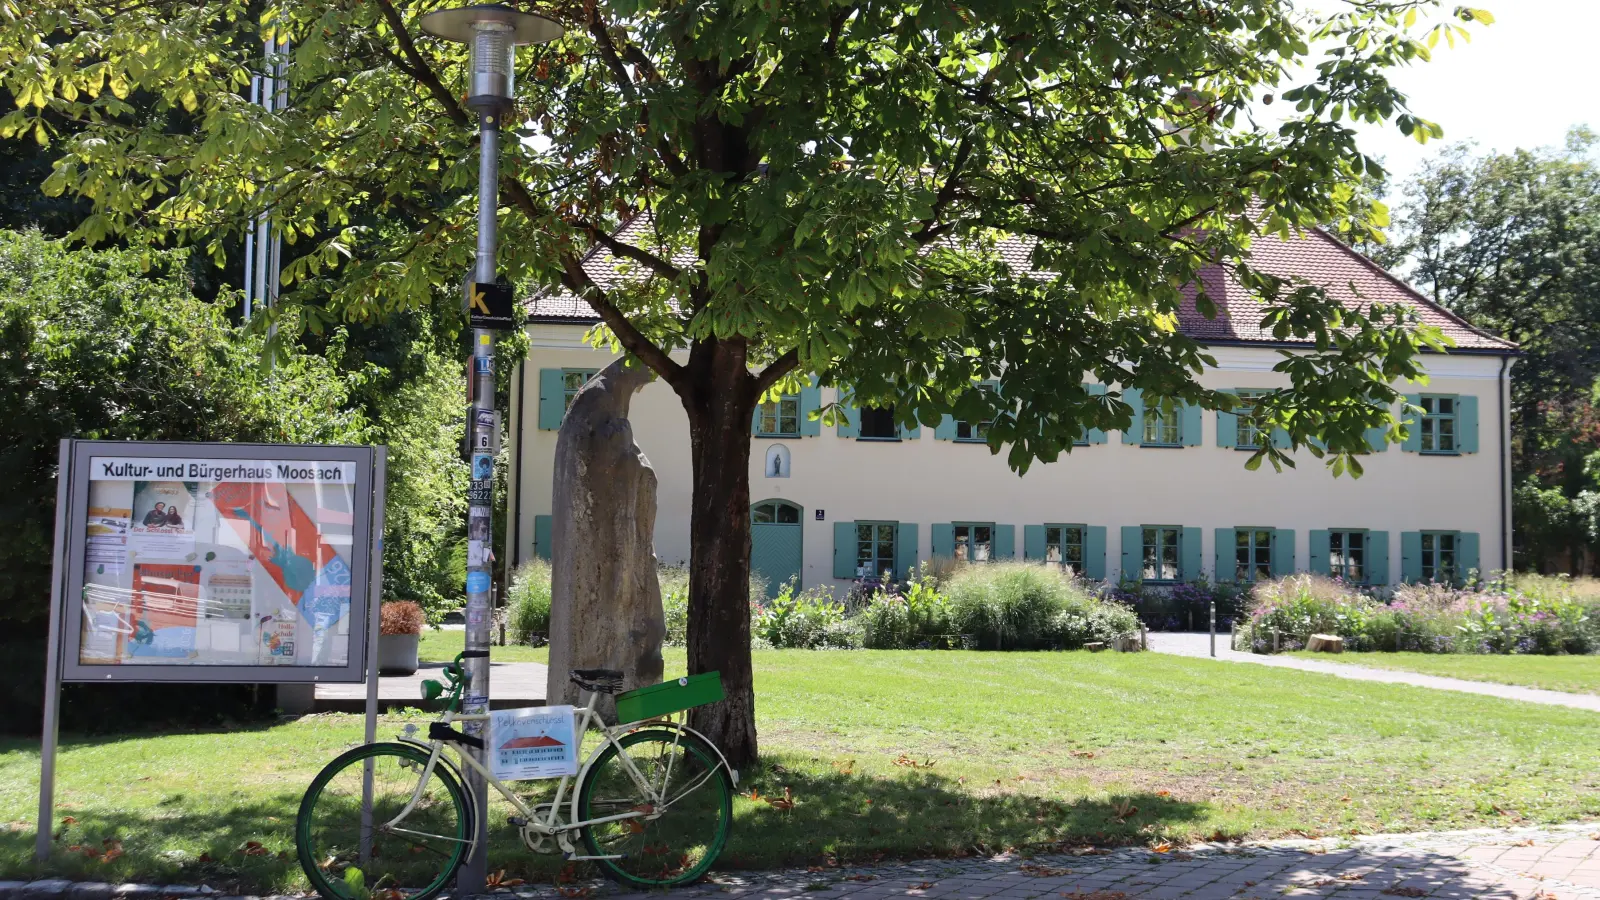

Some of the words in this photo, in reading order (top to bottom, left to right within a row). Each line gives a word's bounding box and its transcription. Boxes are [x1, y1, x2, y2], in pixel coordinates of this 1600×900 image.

[481, 436, 488, 447] 6
[102, 461, 153, 478] Kultur-
[156, 463, 184, 478] und
[188, 463, 273, 482] Bürgerhaus
[276, 464, 342, 480] Moosach
